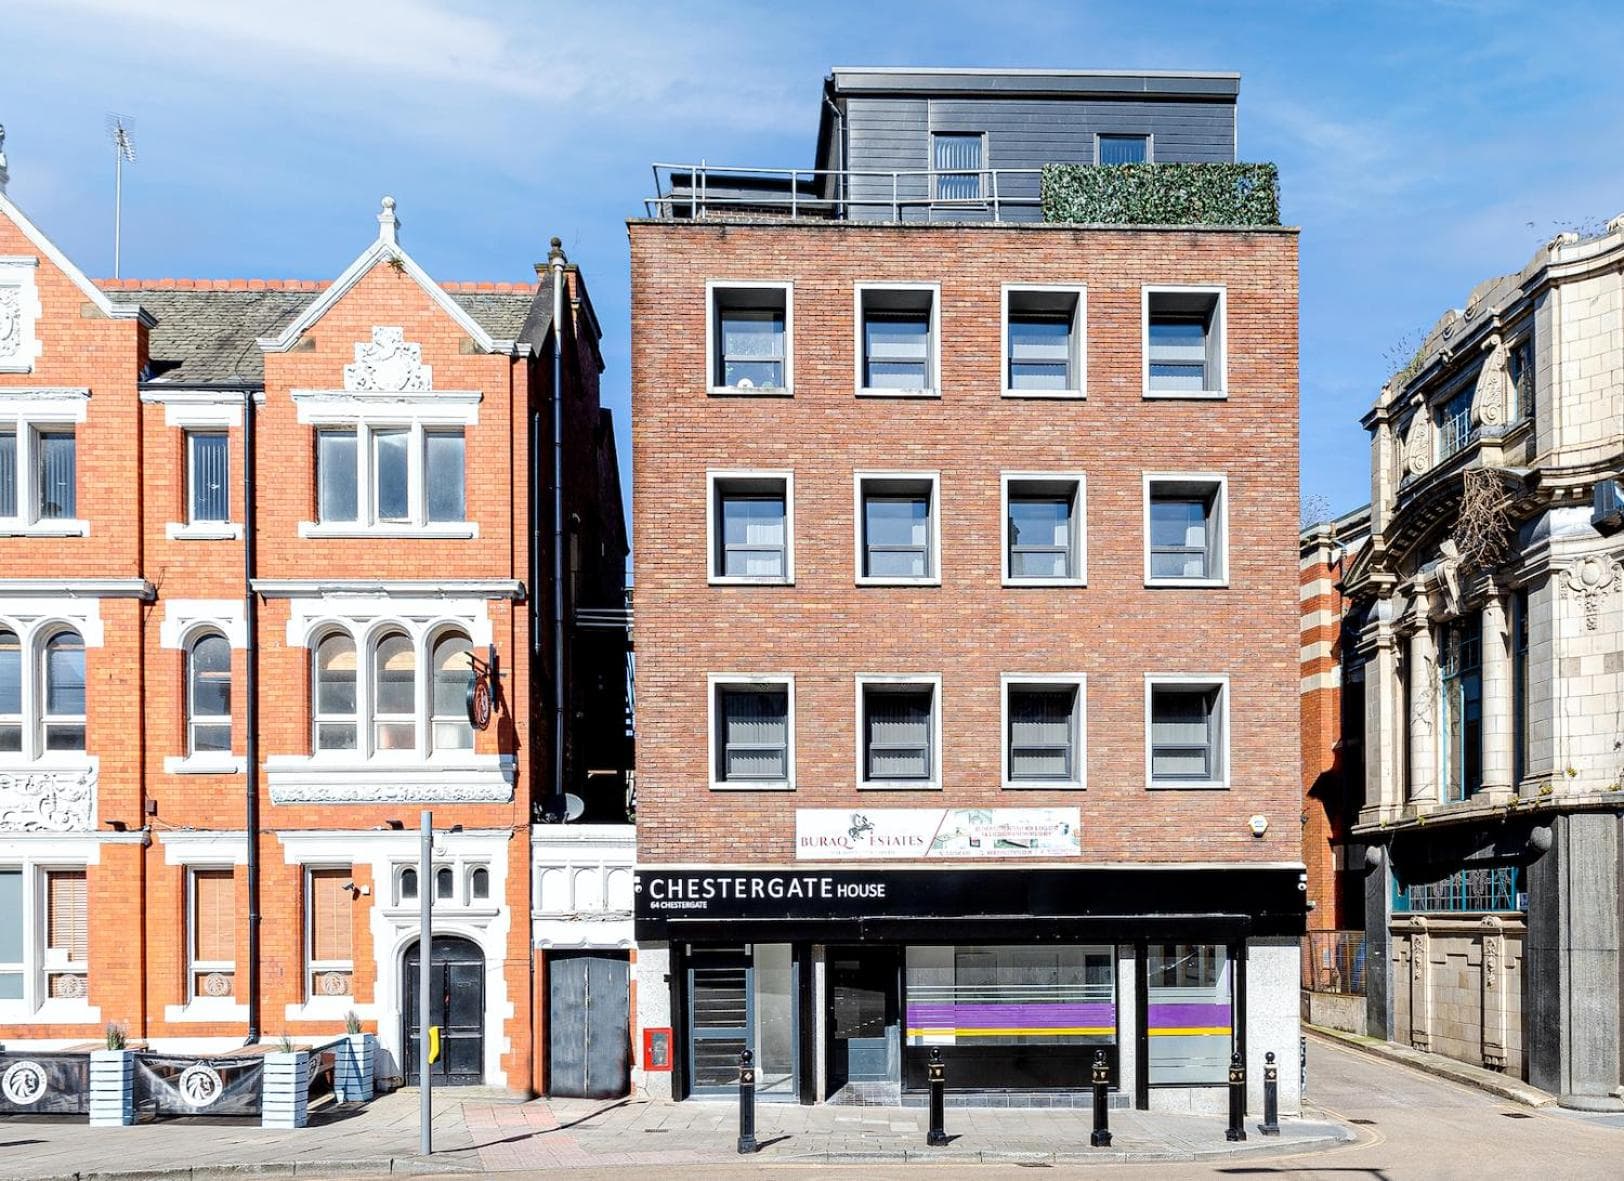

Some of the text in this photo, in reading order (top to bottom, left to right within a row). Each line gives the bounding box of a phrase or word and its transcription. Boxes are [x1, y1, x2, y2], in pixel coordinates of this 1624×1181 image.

[801, 831, 924, 849] BURAQ ESTATES
[649, 878, 886, 898] CHESTERGATE HOUSE
[650, 901, 707, 909] 64 CHESTERGATE
